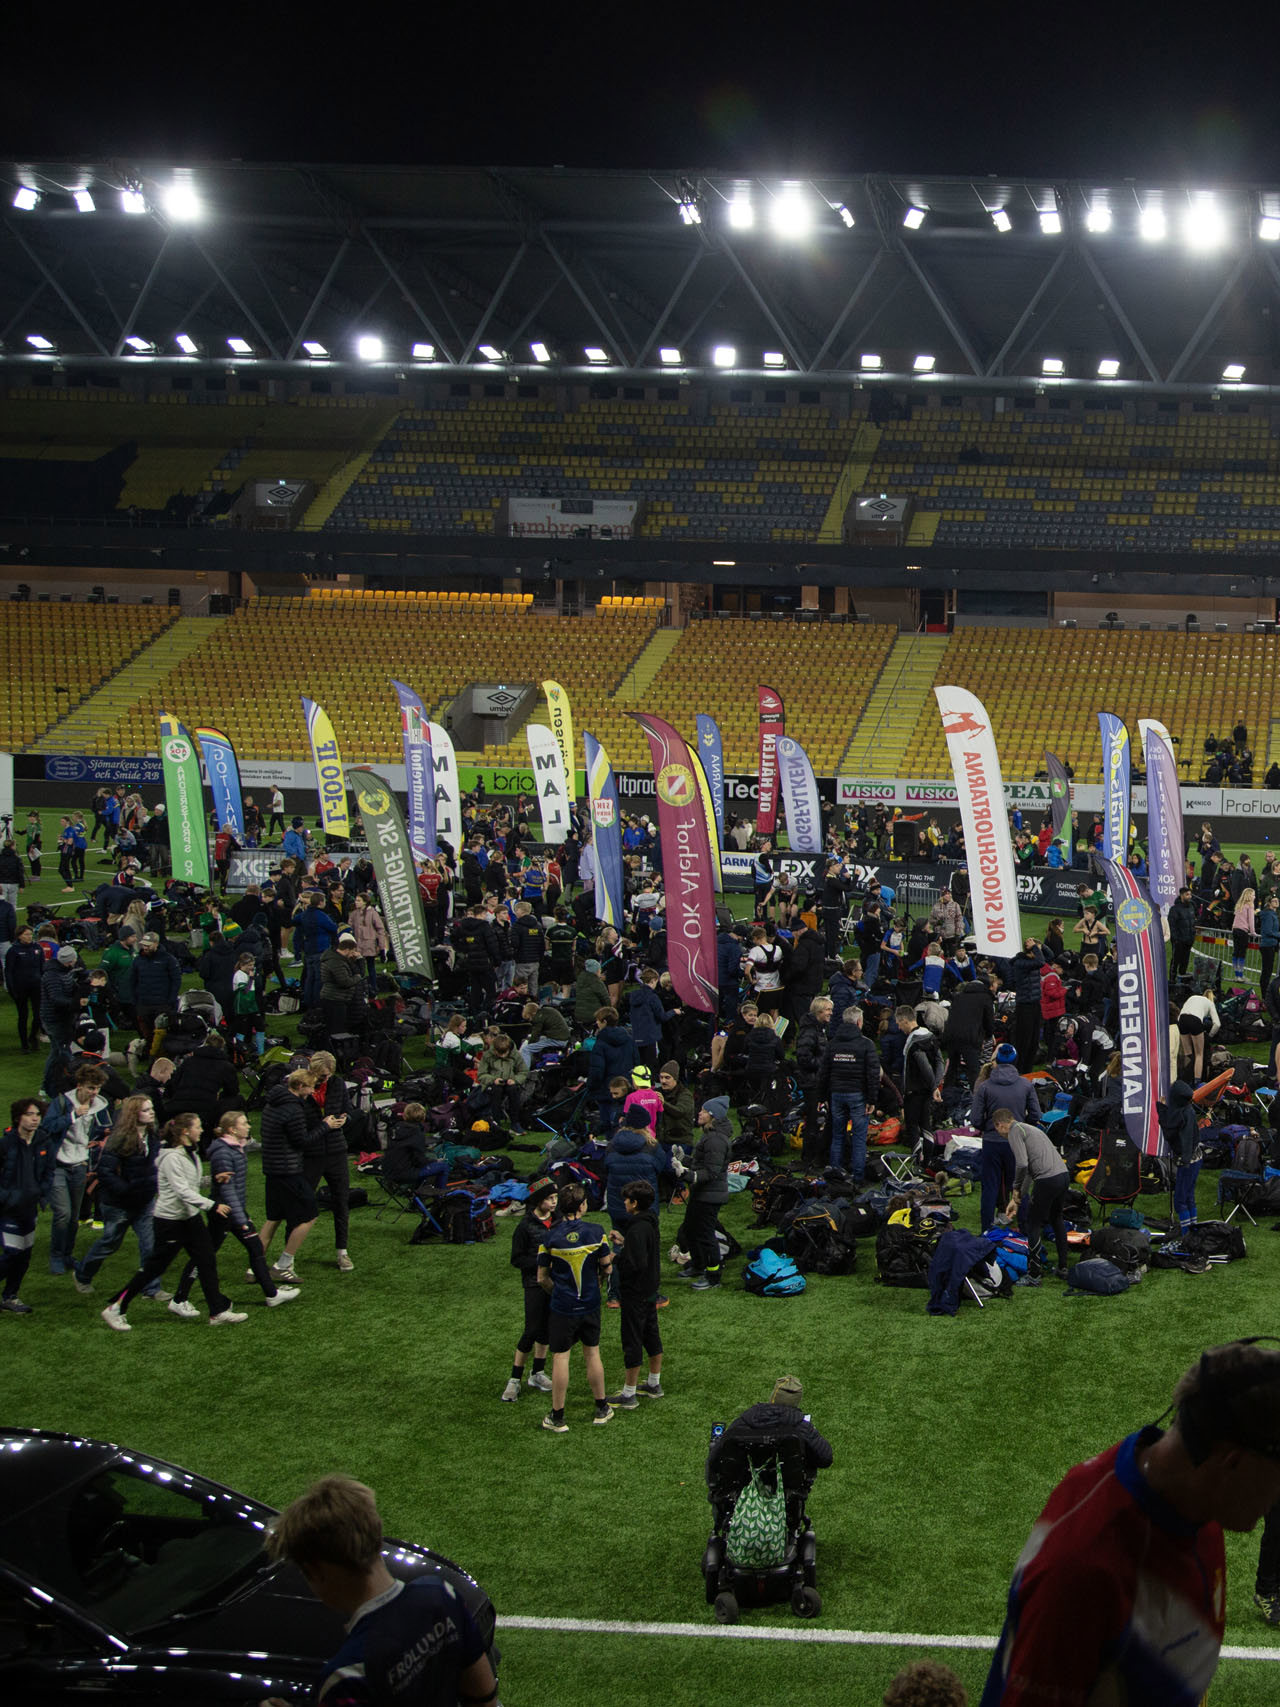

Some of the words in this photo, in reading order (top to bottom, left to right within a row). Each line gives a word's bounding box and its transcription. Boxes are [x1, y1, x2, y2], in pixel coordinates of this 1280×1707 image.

[88, 759, 139, 771] Sjömarkens
[95, 770, 111, 779] och
[113, 770, 141, 780] Smide
[143, 772, 160, 780] AB
[493, 772, 537, 790] brio
[844, 785, 894, 798] VISKO
[907, 786, 958, 799] VISKO
[1016, 874, 1044, 895] EDX
[1018, 894, 1038, 902] GHTS
[1059, 890, 1080, 899] DARKNES
